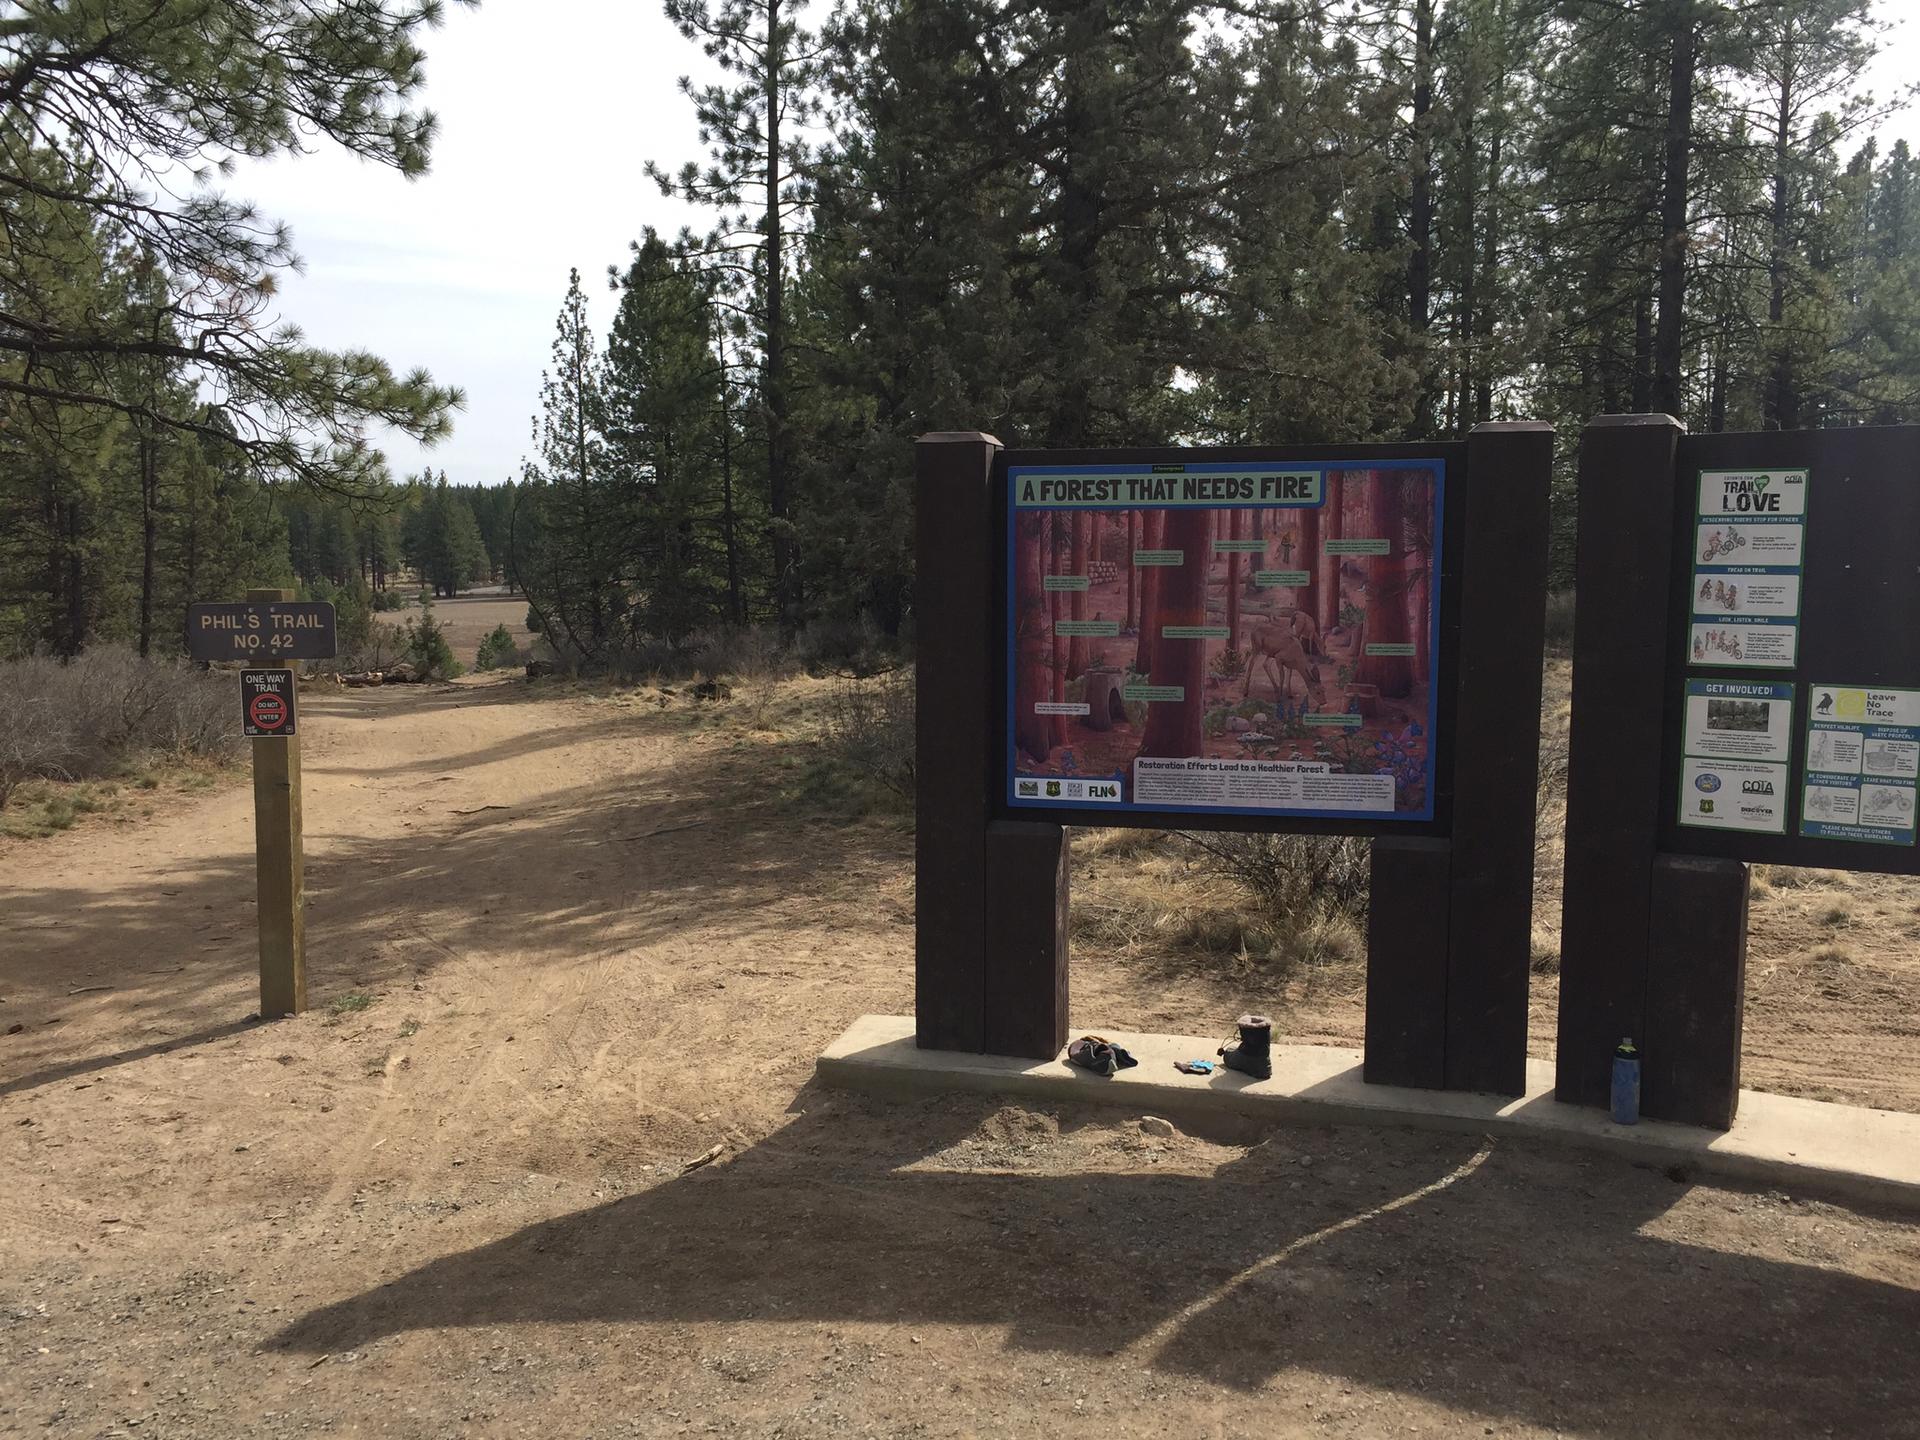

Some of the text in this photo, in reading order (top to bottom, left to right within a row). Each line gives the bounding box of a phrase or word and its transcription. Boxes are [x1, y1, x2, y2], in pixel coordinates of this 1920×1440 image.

[1023, 476, 1313, 501] A FOREST THAT NEEDS FIRE
[1722, 493, 1780, 512] LOVE
[201, 614, 324, 629] PHIL'S TRAIL
[234, 634, 294, 648] NO. 42
[245, 674, 286, 683] ONE WAY
[254, 684, 280, 692] TRAIL
[1706, 684, 1773, 695] GET INVOLVED!
[1867, 692, 1897, 701] Leave
[1867, 709, 1894, 717] Trace
[1138, 761, 1186, 770] Restoration
[1187, 761, 1217, 771] Efforts
[1219, 763, 1239, 771] Lead
[1240, 764, 1249, 772] to
[1258, 763, 1295, 773] Healthier
[1297, 764, 1324, 774] Forest
[1088, 786, 1108, 798] FLN
[1742, 780, 1774, 793] COTA
[1741, 806, 1773, 814] DISCOVER
